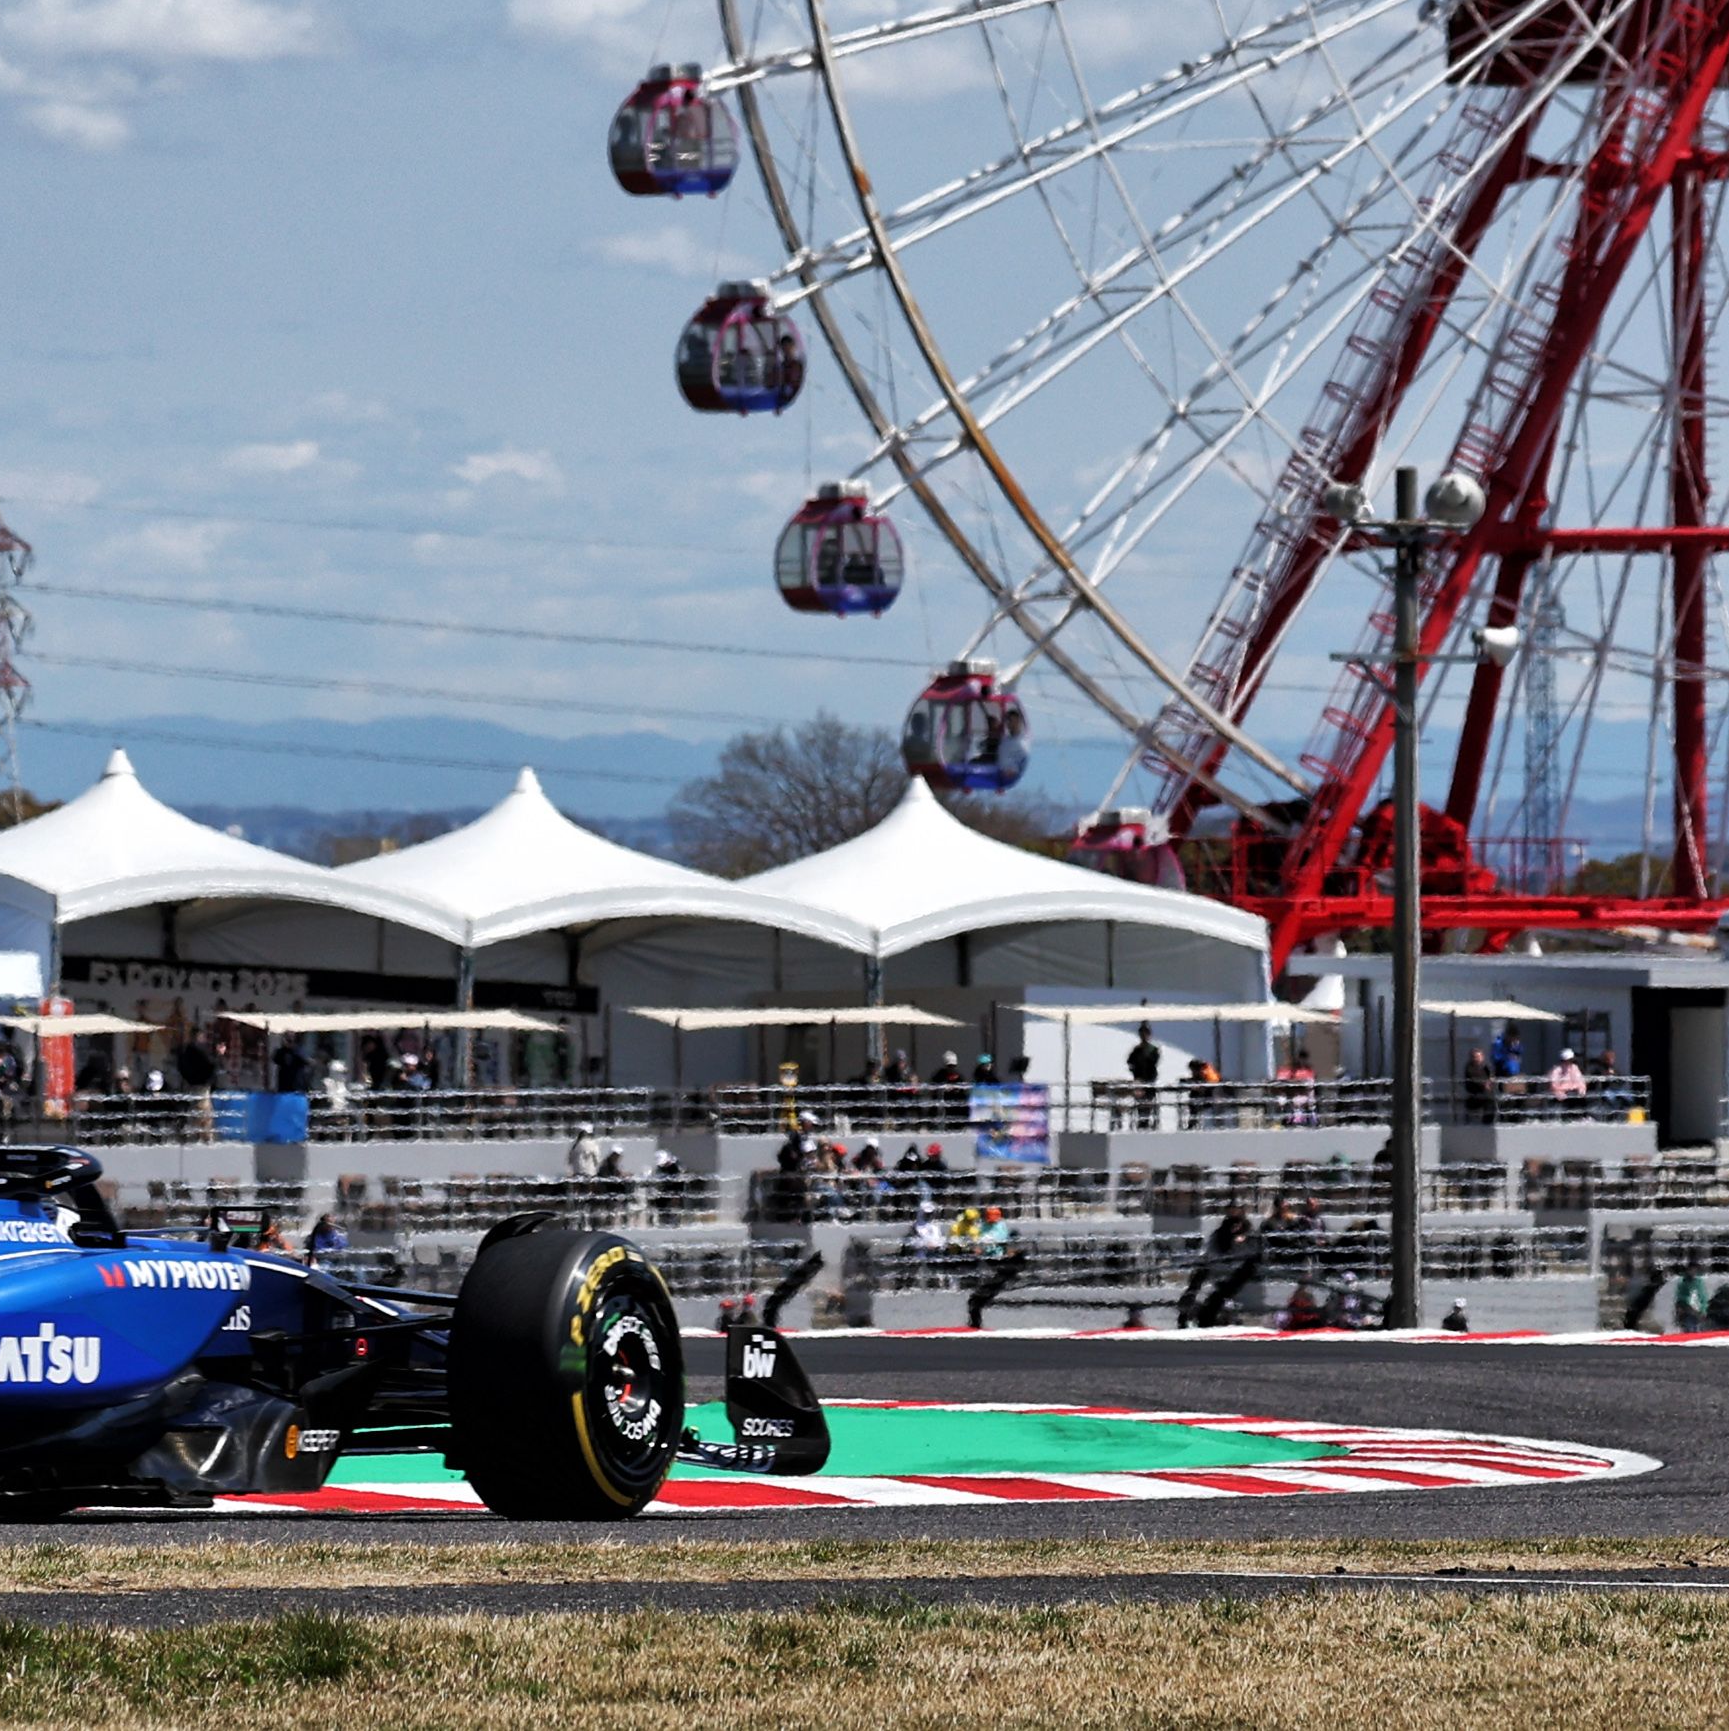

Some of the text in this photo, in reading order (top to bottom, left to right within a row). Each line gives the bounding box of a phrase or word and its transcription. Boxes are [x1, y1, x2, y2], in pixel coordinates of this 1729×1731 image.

[576, 1246, 626, 1313] ZERO
[743, 1345, 776, 1379] bw
[297, 1429, 341, 1452] KEEPER
[742, 1418, 795, 1438] SCORES
